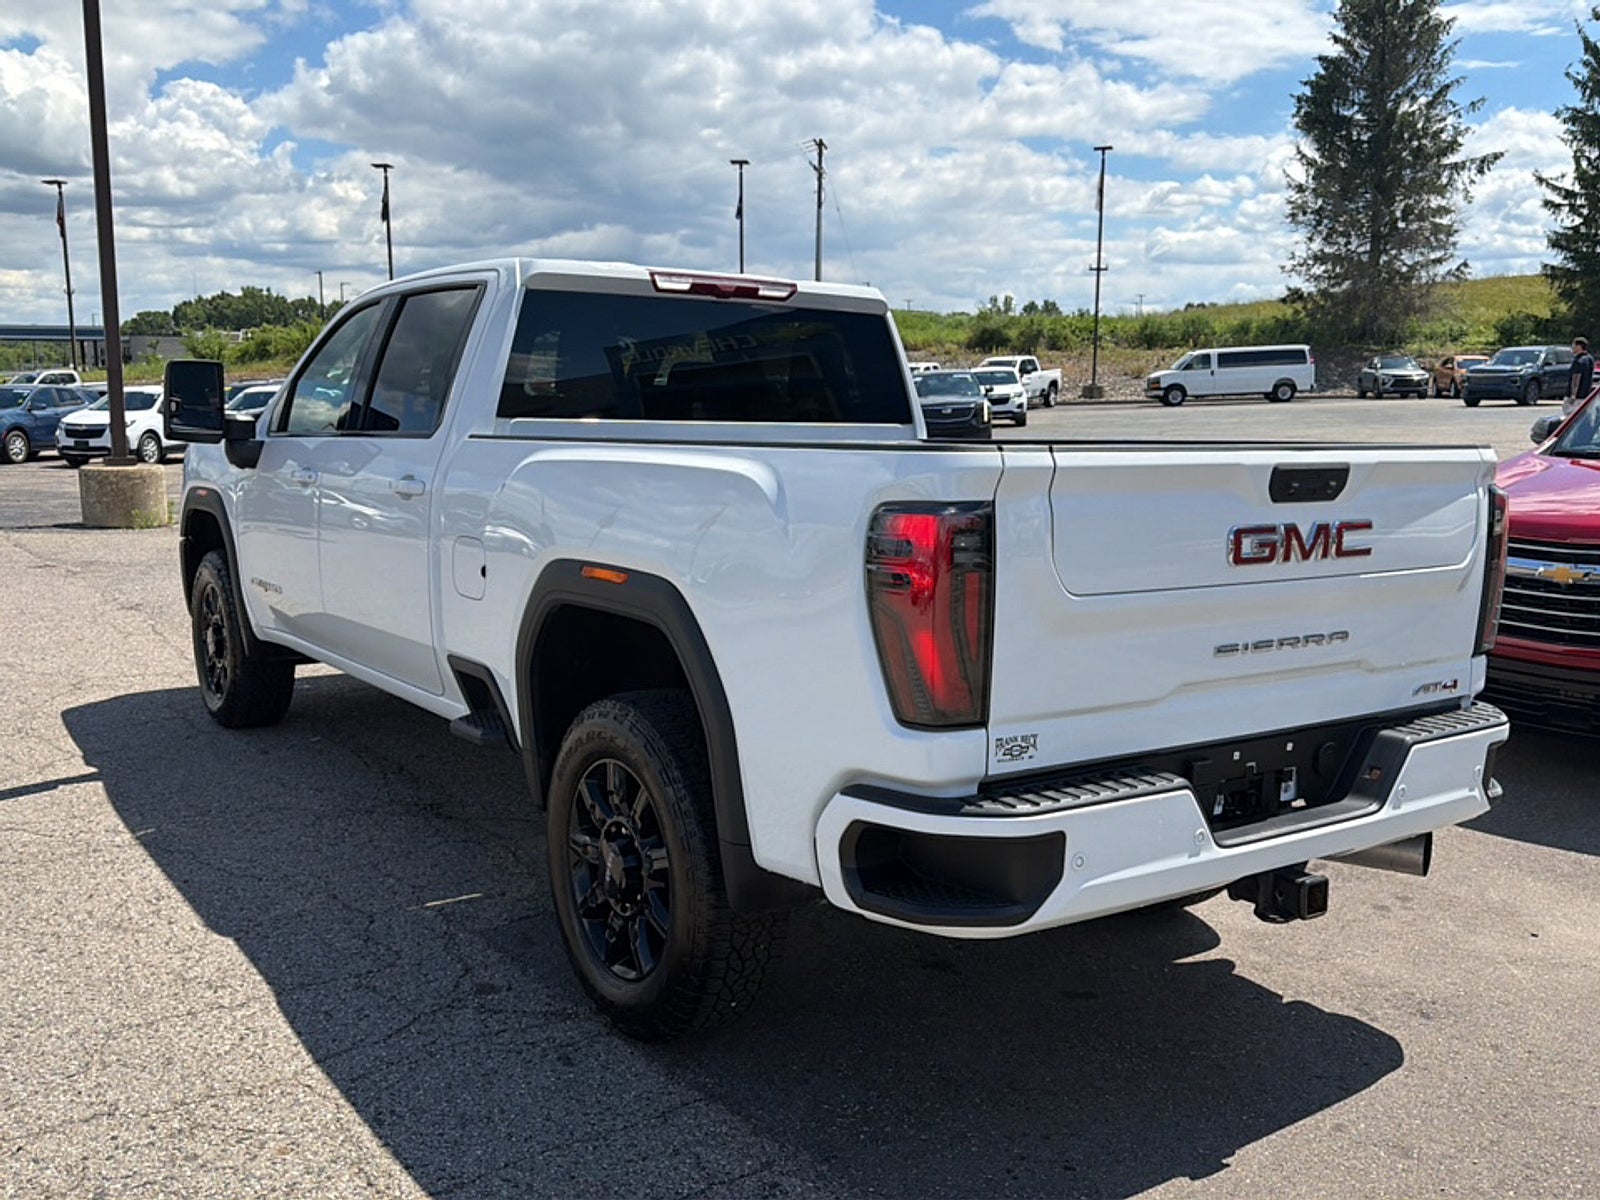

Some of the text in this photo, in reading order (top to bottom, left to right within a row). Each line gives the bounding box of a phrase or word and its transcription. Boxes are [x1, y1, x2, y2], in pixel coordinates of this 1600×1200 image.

[1227, 519, 1373, 566] GMC
[1213, 630, 1350, 658] SIERRA
[1412, 679, 1458, 696] AT4
